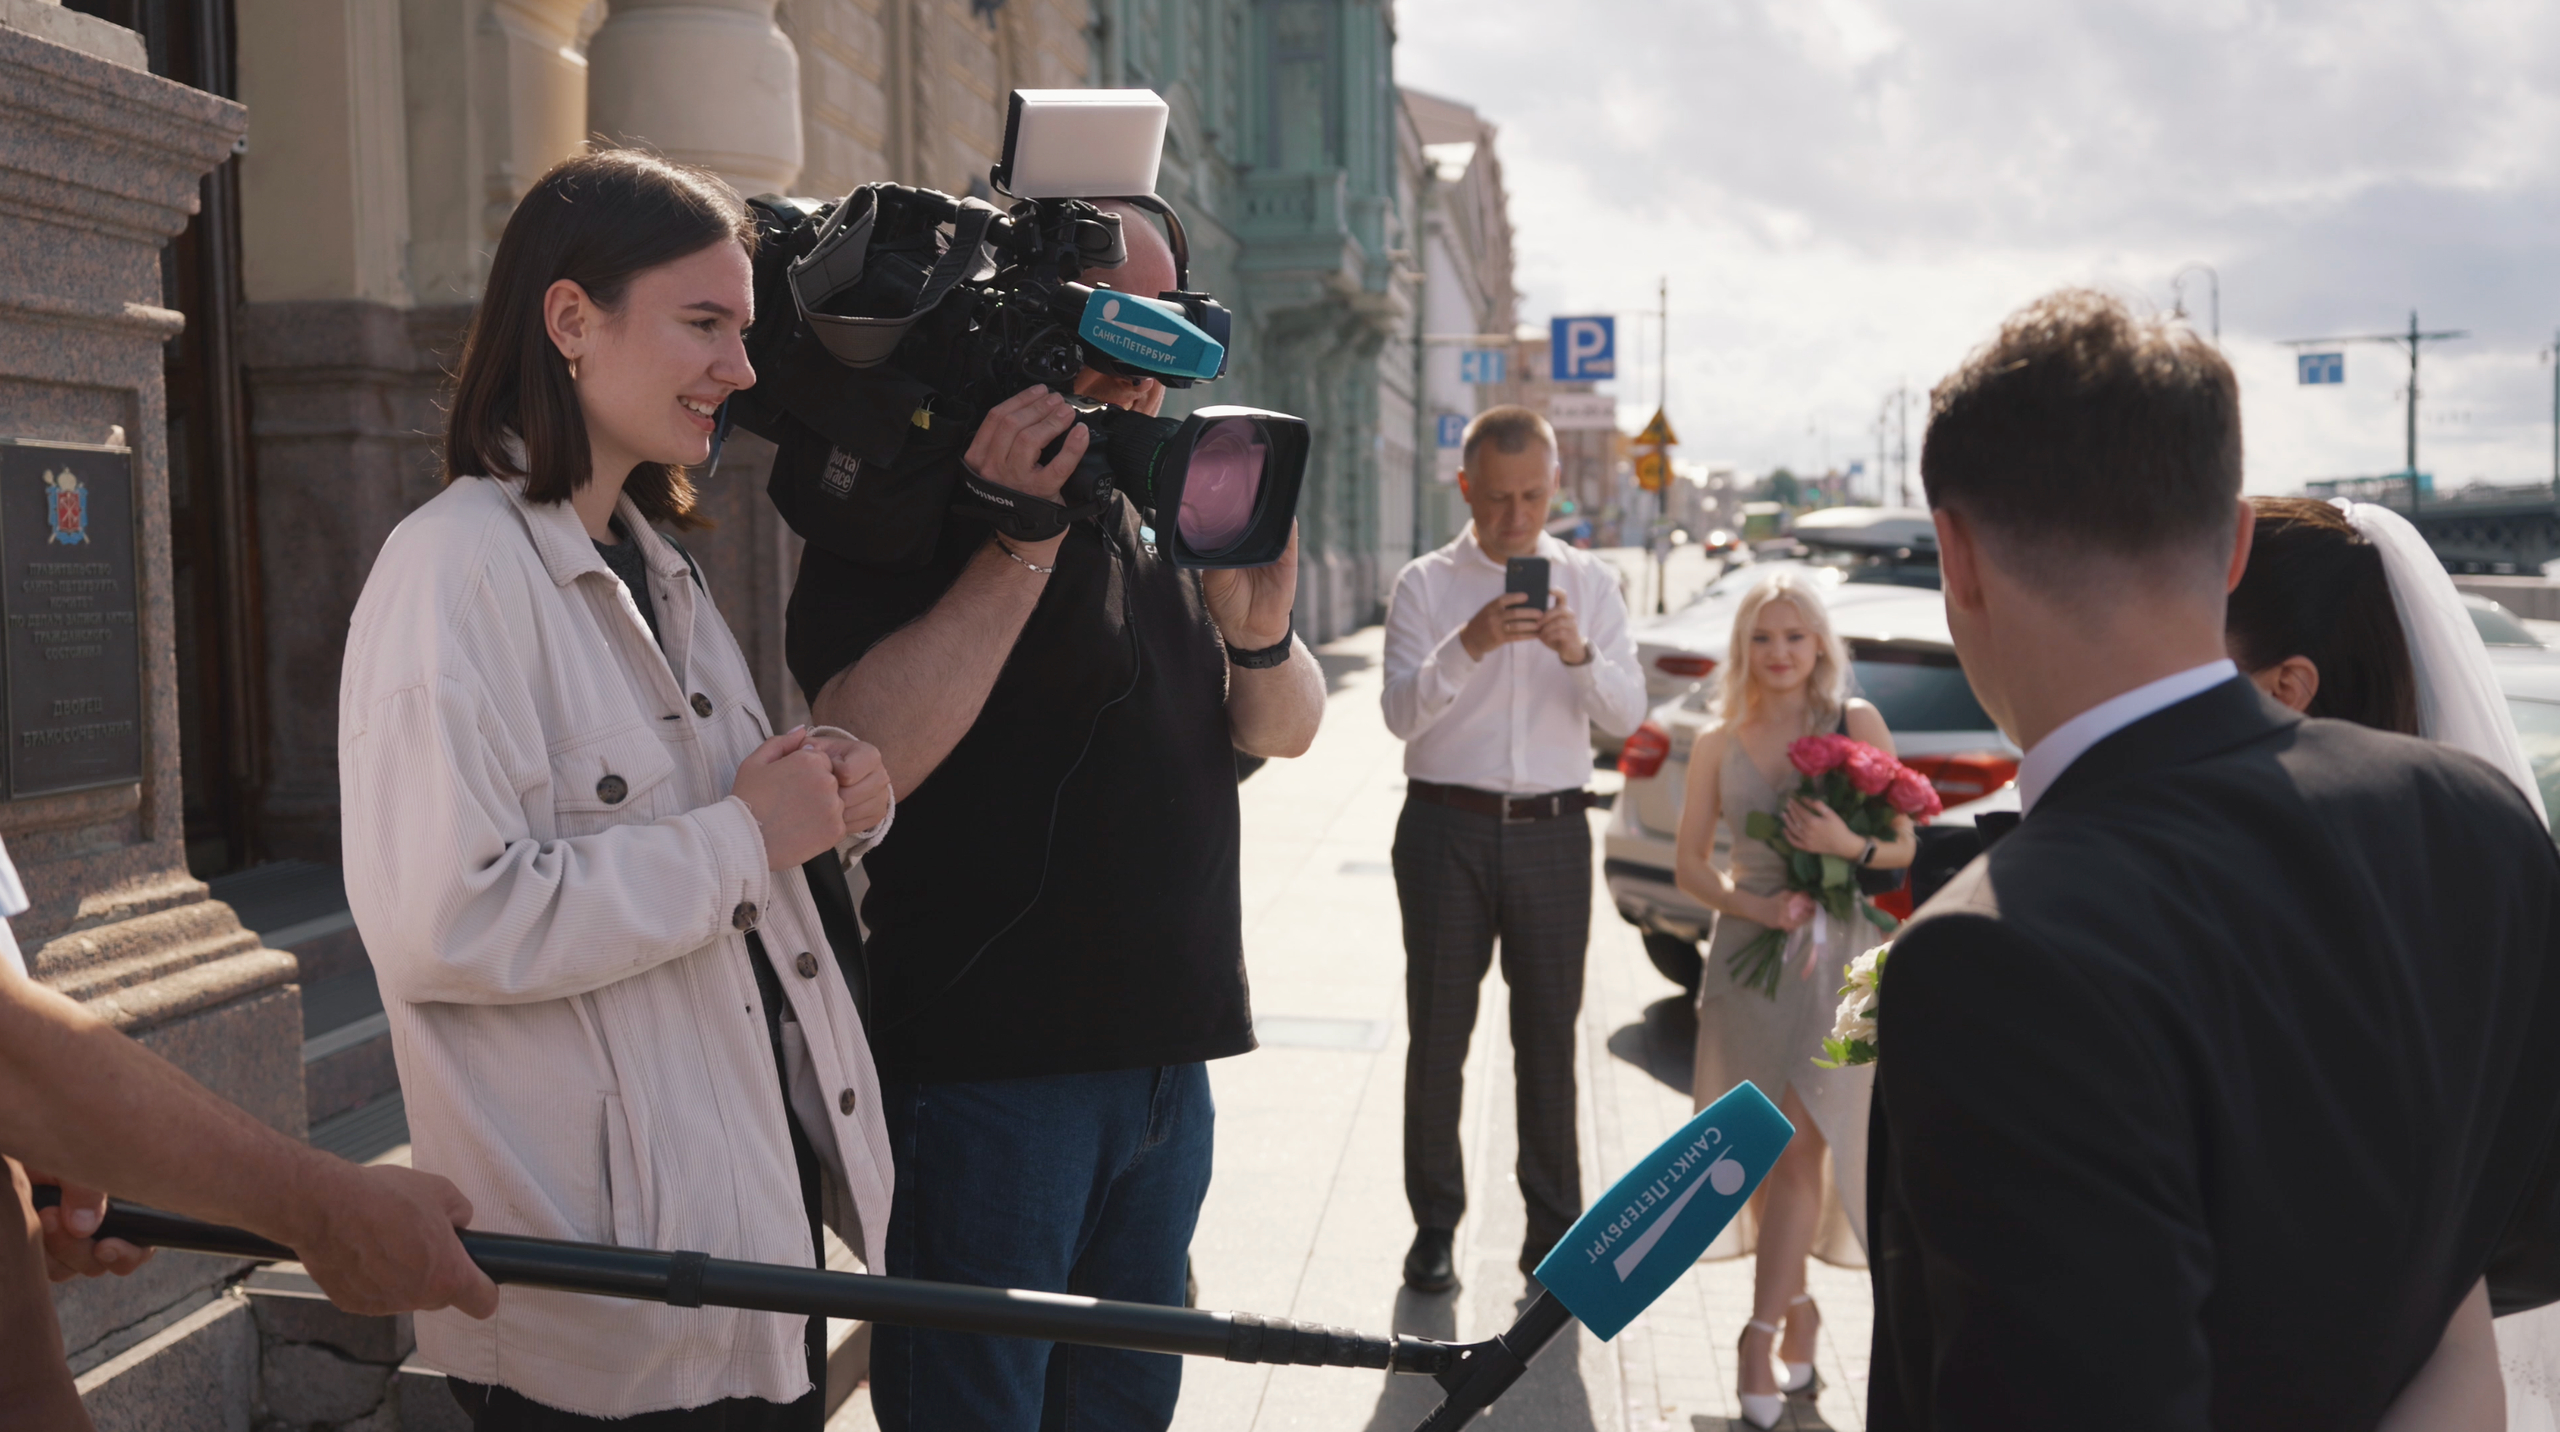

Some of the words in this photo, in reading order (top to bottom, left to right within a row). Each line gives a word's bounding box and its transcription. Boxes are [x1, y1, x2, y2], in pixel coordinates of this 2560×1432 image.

[1092, 325, 1176, 365] САНКТ-ПЕТЕРБУРГ
[1567, 321, 1607, 377] P
[53, 696, 103, 717] ДВОРЕЦ
[1585, 1126, 1722, 1264] САНКТ-ПЕТЕРБУРГ
